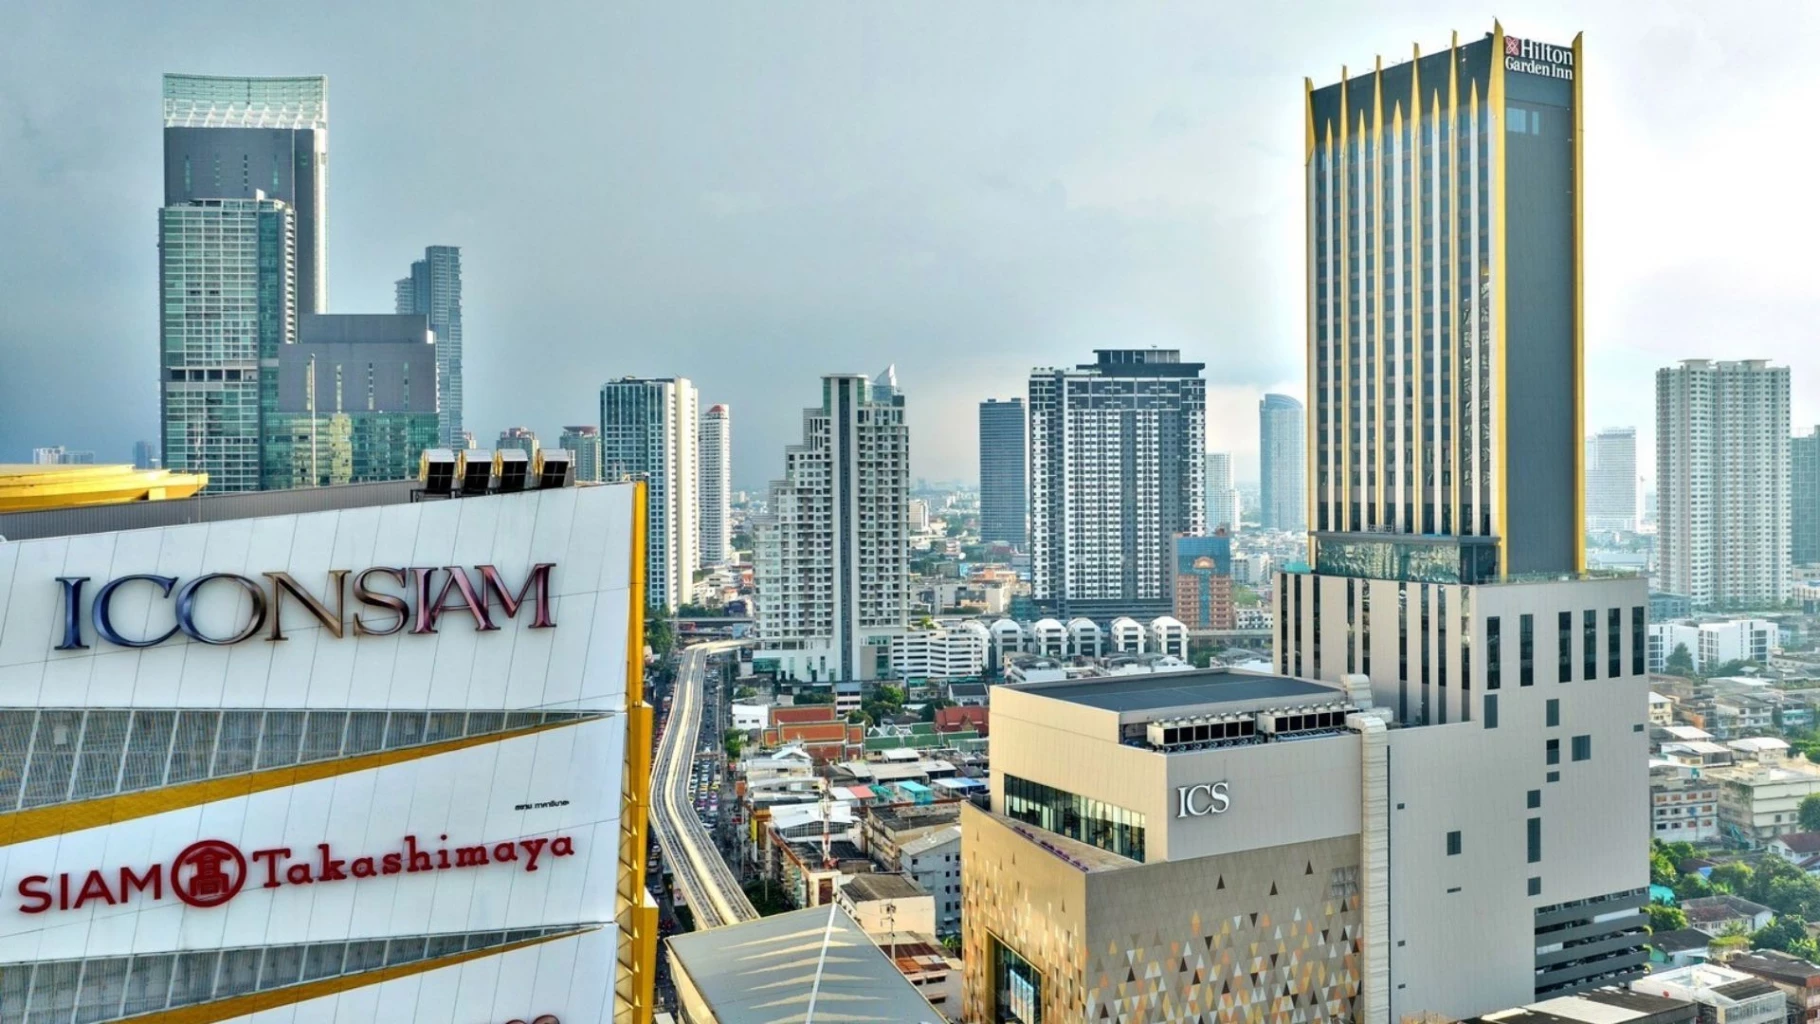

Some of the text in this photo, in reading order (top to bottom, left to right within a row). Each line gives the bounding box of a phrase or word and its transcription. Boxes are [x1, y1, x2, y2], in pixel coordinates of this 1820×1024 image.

[1505, 56, 1573, 80] Garden Inn
[1520, 38, 1573, 66] Hilton
[54, 562, 558, 652] ICONSIAM
[1177, 781, 1230, 819] ICS
[18, 863, 162, 914] SIAM
[253, 834, 575, 889] Takashimaya
